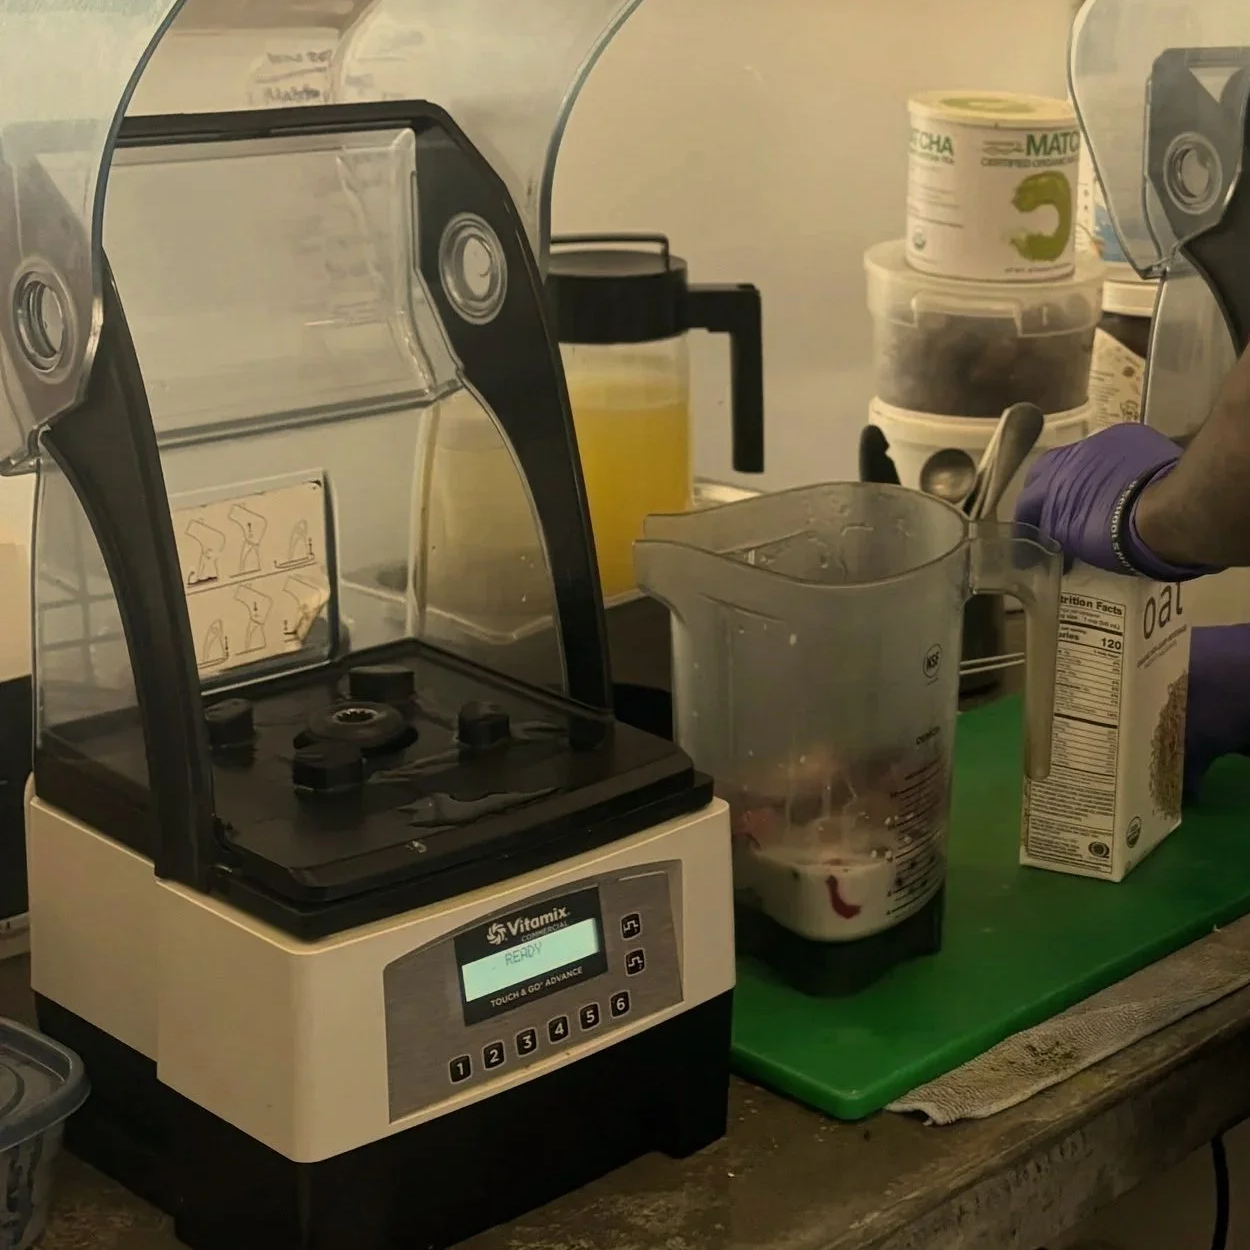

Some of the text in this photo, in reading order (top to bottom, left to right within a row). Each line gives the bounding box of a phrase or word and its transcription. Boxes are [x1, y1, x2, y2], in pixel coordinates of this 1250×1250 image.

[920, 132, 953, 156] CHA
[1026, 130, 1080, 156] MATC
[1060, 595, 1093, 608] trition
[1096, 602, 1122, 615] Facts
[1102, 638, 1121, 650] 120
[507, 906, 567, 936] Vitamix
[521, 921, 568, 943] COMMERCIAL
[505, 942, 542, 966] READY
[490, 990, 520, 1007] TOUCH
[520, 987, 527, 997] &
[545, 966, 583, 987] ADVANCE
[457, 997, 625, 1076] 1 2 3 4 5 6
